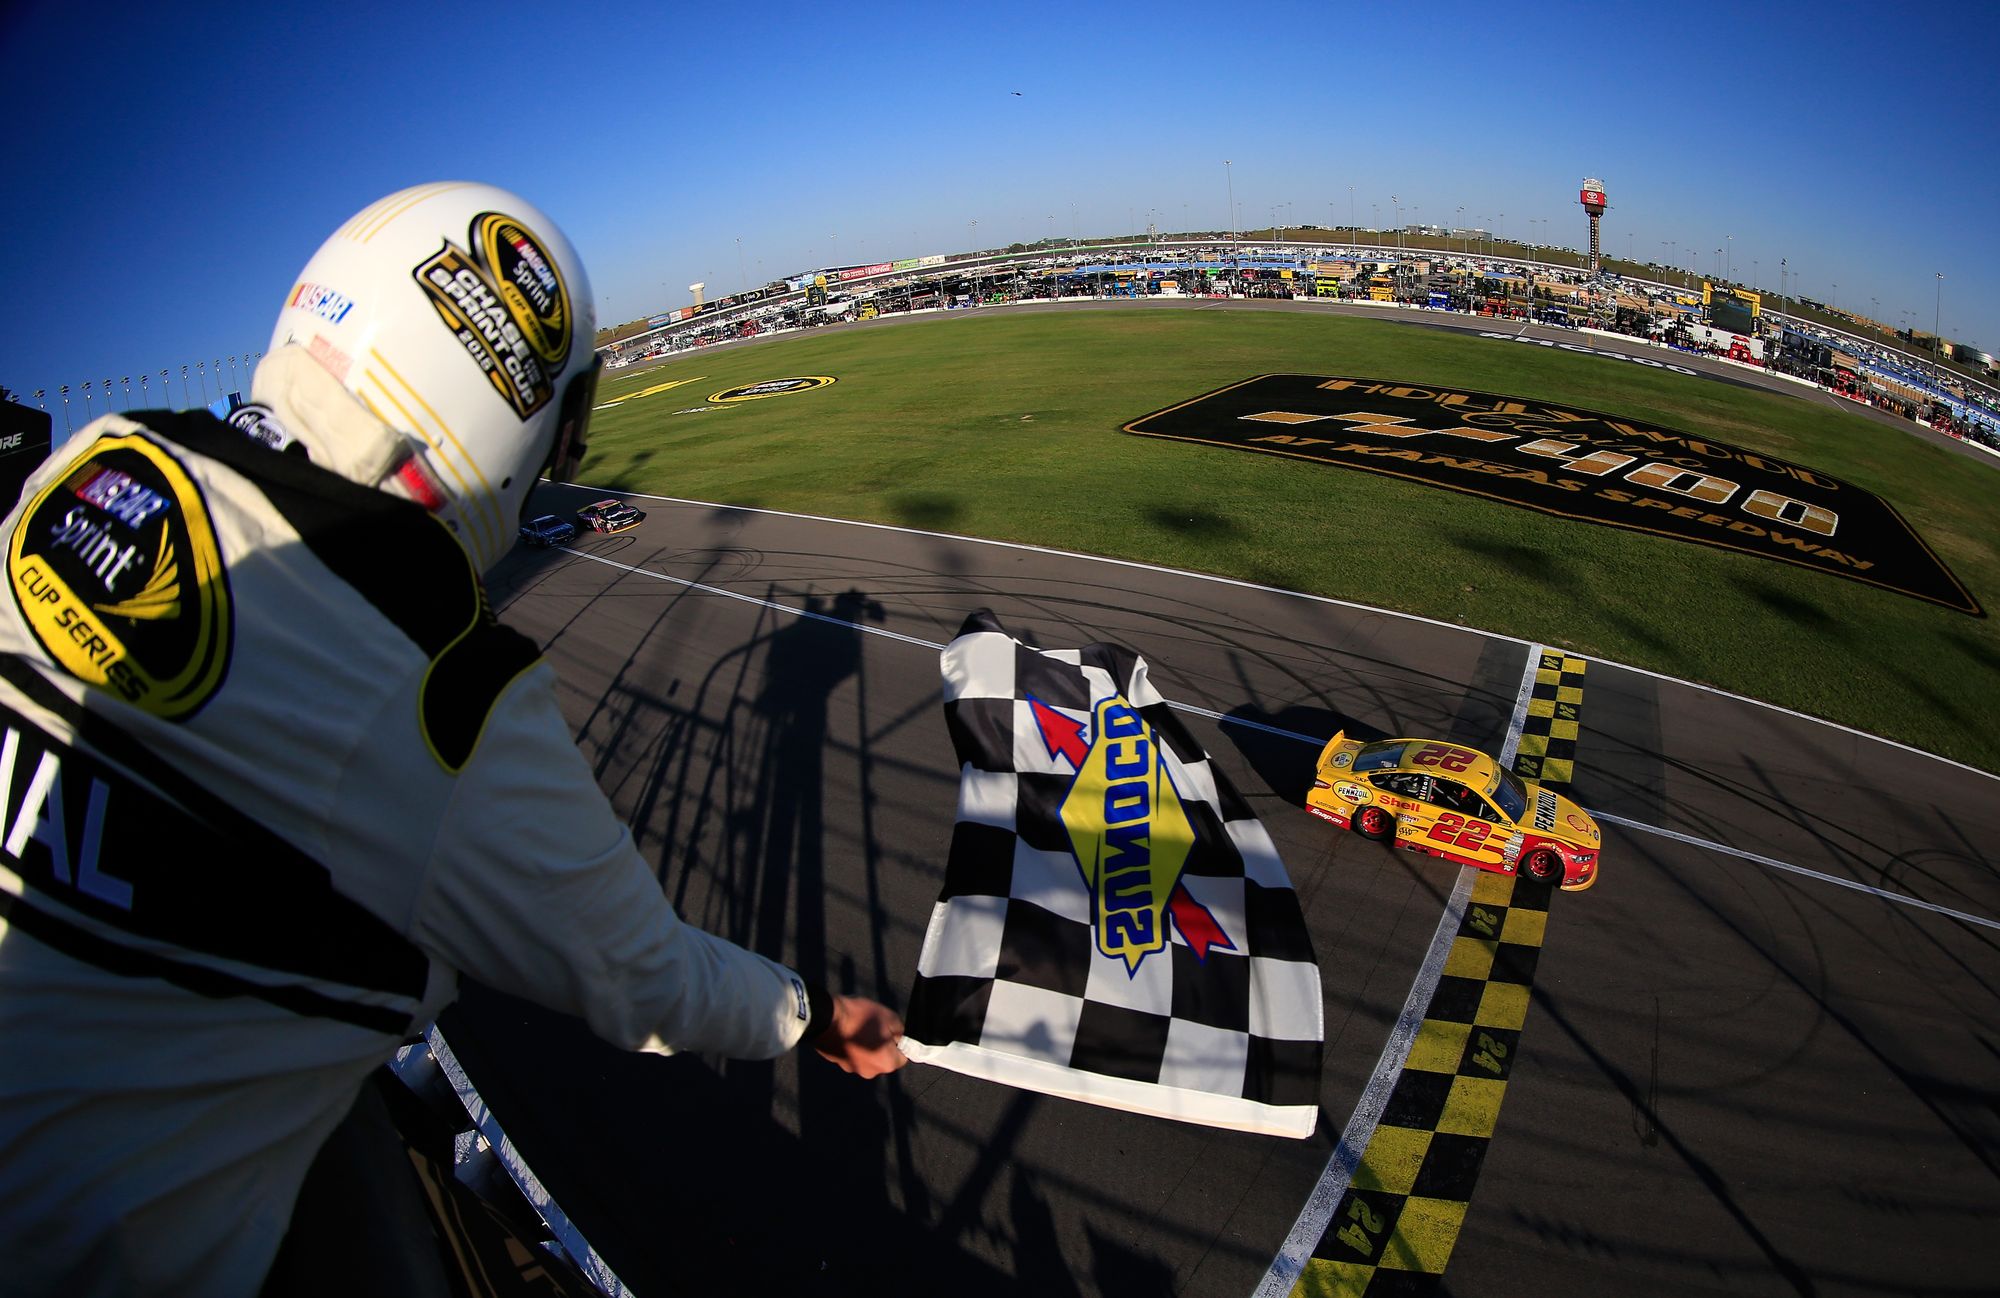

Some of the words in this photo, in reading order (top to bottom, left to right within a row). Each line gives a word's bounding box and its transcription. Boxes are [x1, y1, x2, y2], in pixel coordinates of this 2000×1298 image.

[513, 260, 550, 313] Sprint
[1714, 285, 1729, 294] Sprint
[1738, 291, 1756, 301] Vision
[429, 268, 511, 353] SPRINT
[504, 355, 535, 405] CUP
[455, 269, 530, 361] CHASE
[1316, 379, 1839, 491] HOLLYWOOD
[1461, 411, 1710, 469] Casino
[1249, 434, 1335, 446] AT
[1331, 443, 1588, 491] KANSAS
[1595, 488, 1875, 570] SPEEDWAY
[1515, 438, 1839, 537] 400
[51, 506, 137, 593] Sprint
[20, 567, 60, 605] CUP
[54, 608, 150, 702] SERIES
[1543, 656, 1560, 670] 24
[1559, 703, 1576, 719] 24
[1412, 743, 1478, 772] 22
[1518, 757, 1538, 776] 24
[1338, 786, 1368, 799] PENNZOIL
[1379, 794, 1421, 812] Shell
[1534, 790, 1557, 833] PENNZOIL
[1310, 808, 1343, 825] Snap-on
[1427, 812, 1492, 852] 22
[1469, 907, 1498, 937] 24
[1472, 1032, 1508, 1075] 24
[1336, 1197, 1385, 1257] 24
